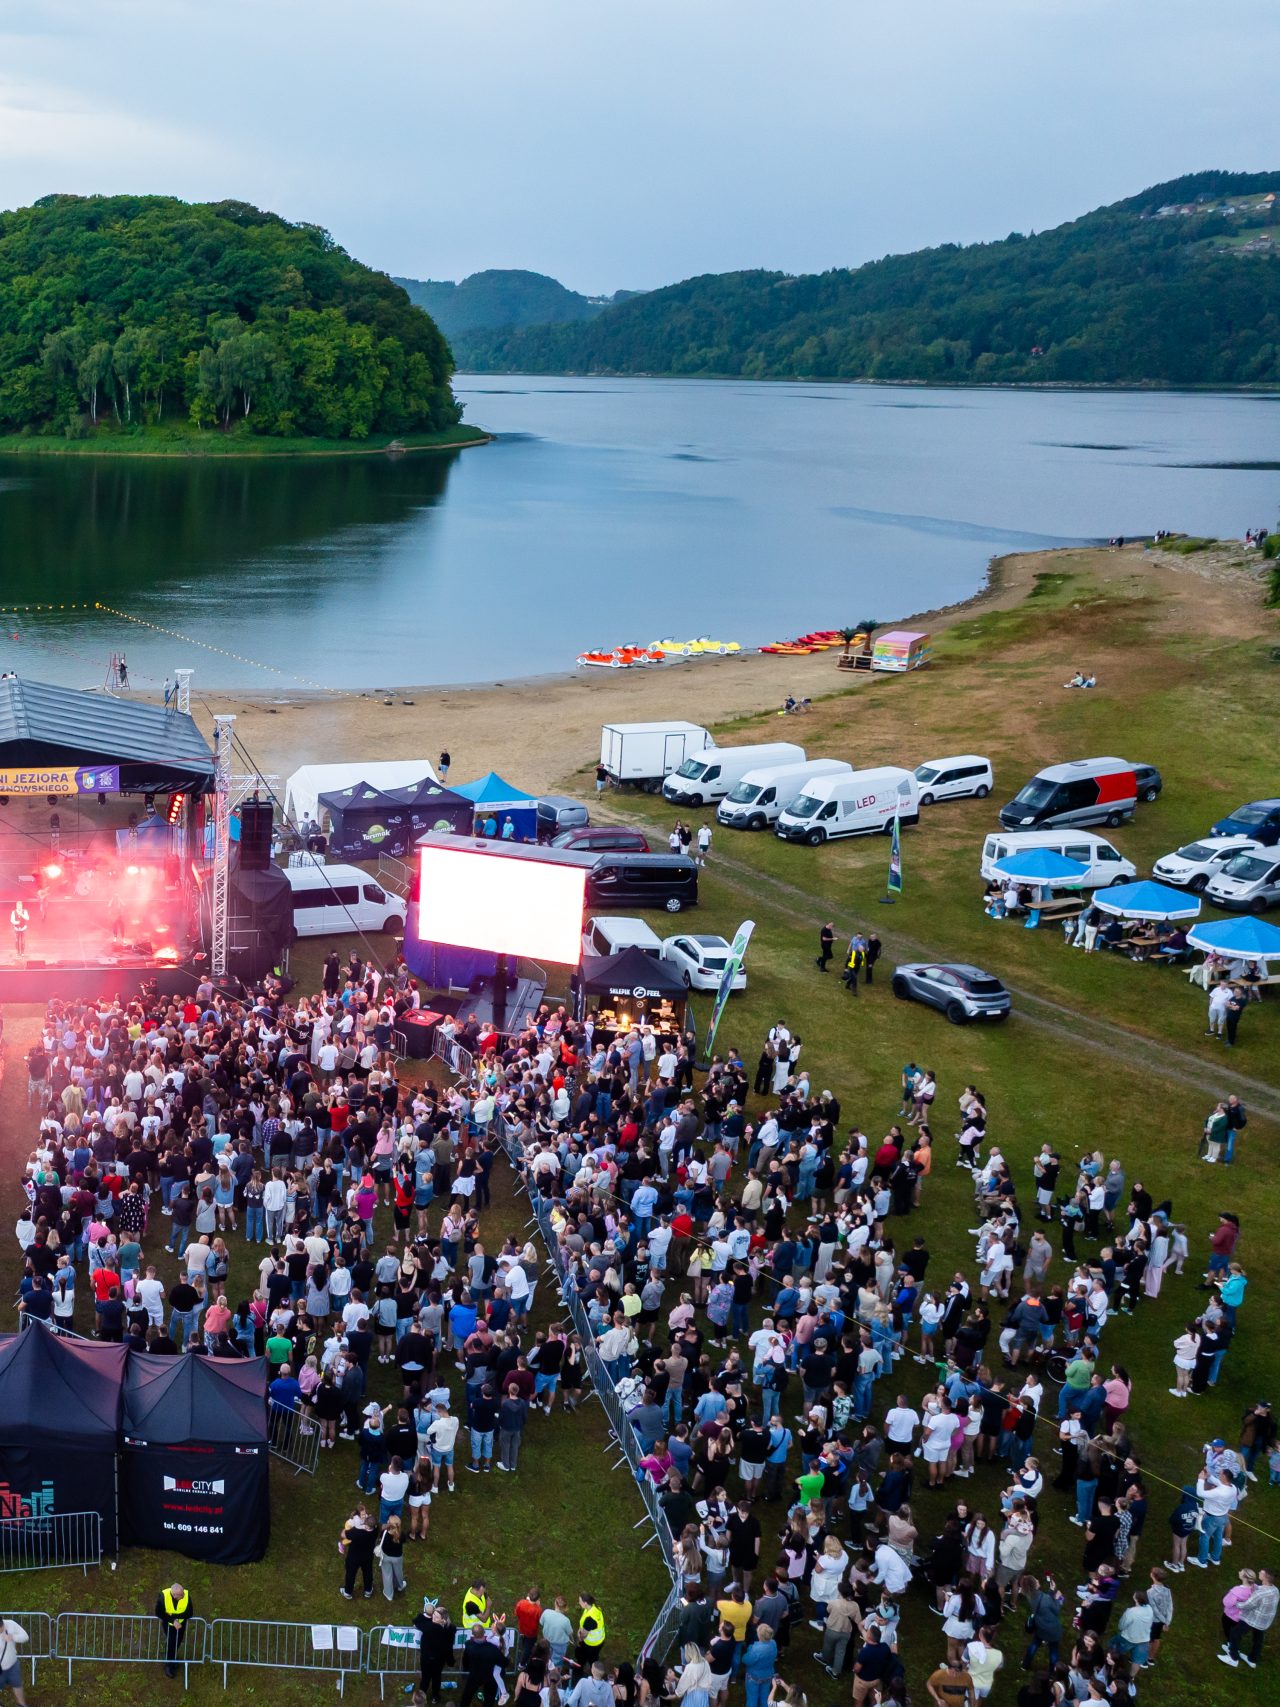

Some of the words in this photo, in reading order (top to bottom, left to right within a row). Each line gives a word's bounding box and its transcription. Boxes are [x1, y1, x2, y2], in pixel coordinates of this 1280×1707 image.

[13, 773, 69, 784] JEZIORA
[609, 987, 631, 996] SKLEPIK
[646, 989, 661, 997] FEEL
[163, 1521, 176, 1530] tel.
[177, 1523, 192, 1532] 609
[194, 1525, 208, 1533] 146
[209, 1526, 224, 1534] 841
